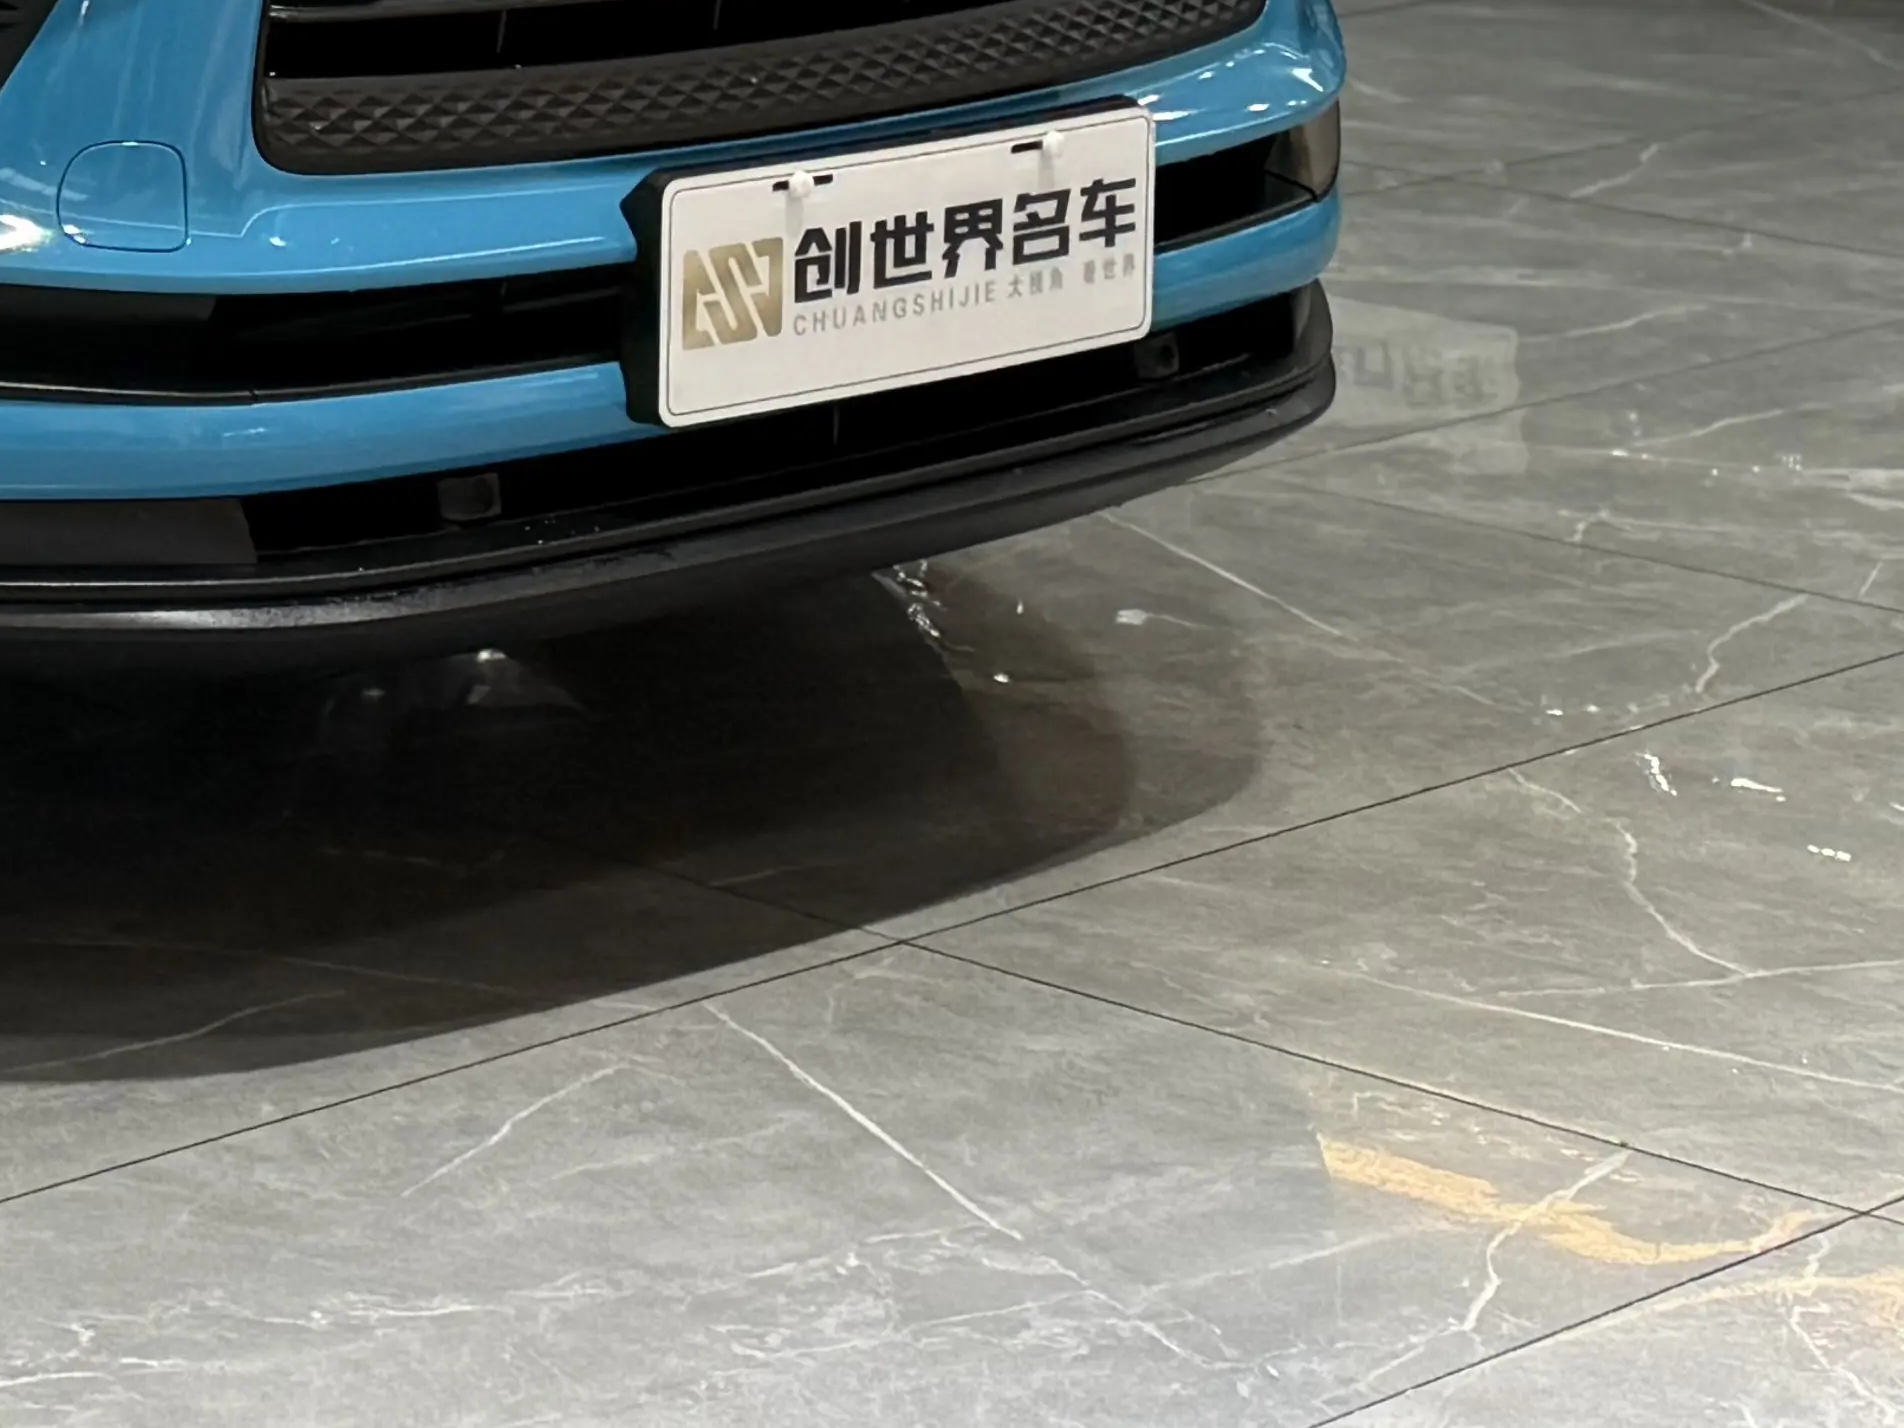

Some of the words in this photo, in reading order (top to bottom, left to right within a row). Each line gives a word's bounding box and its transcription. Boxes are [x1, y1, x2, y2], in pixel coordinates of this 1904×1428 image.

[794, 176, 1138, 305] 创世界名车
[793, 281, 999, 337] CHUANGSHIJIE
